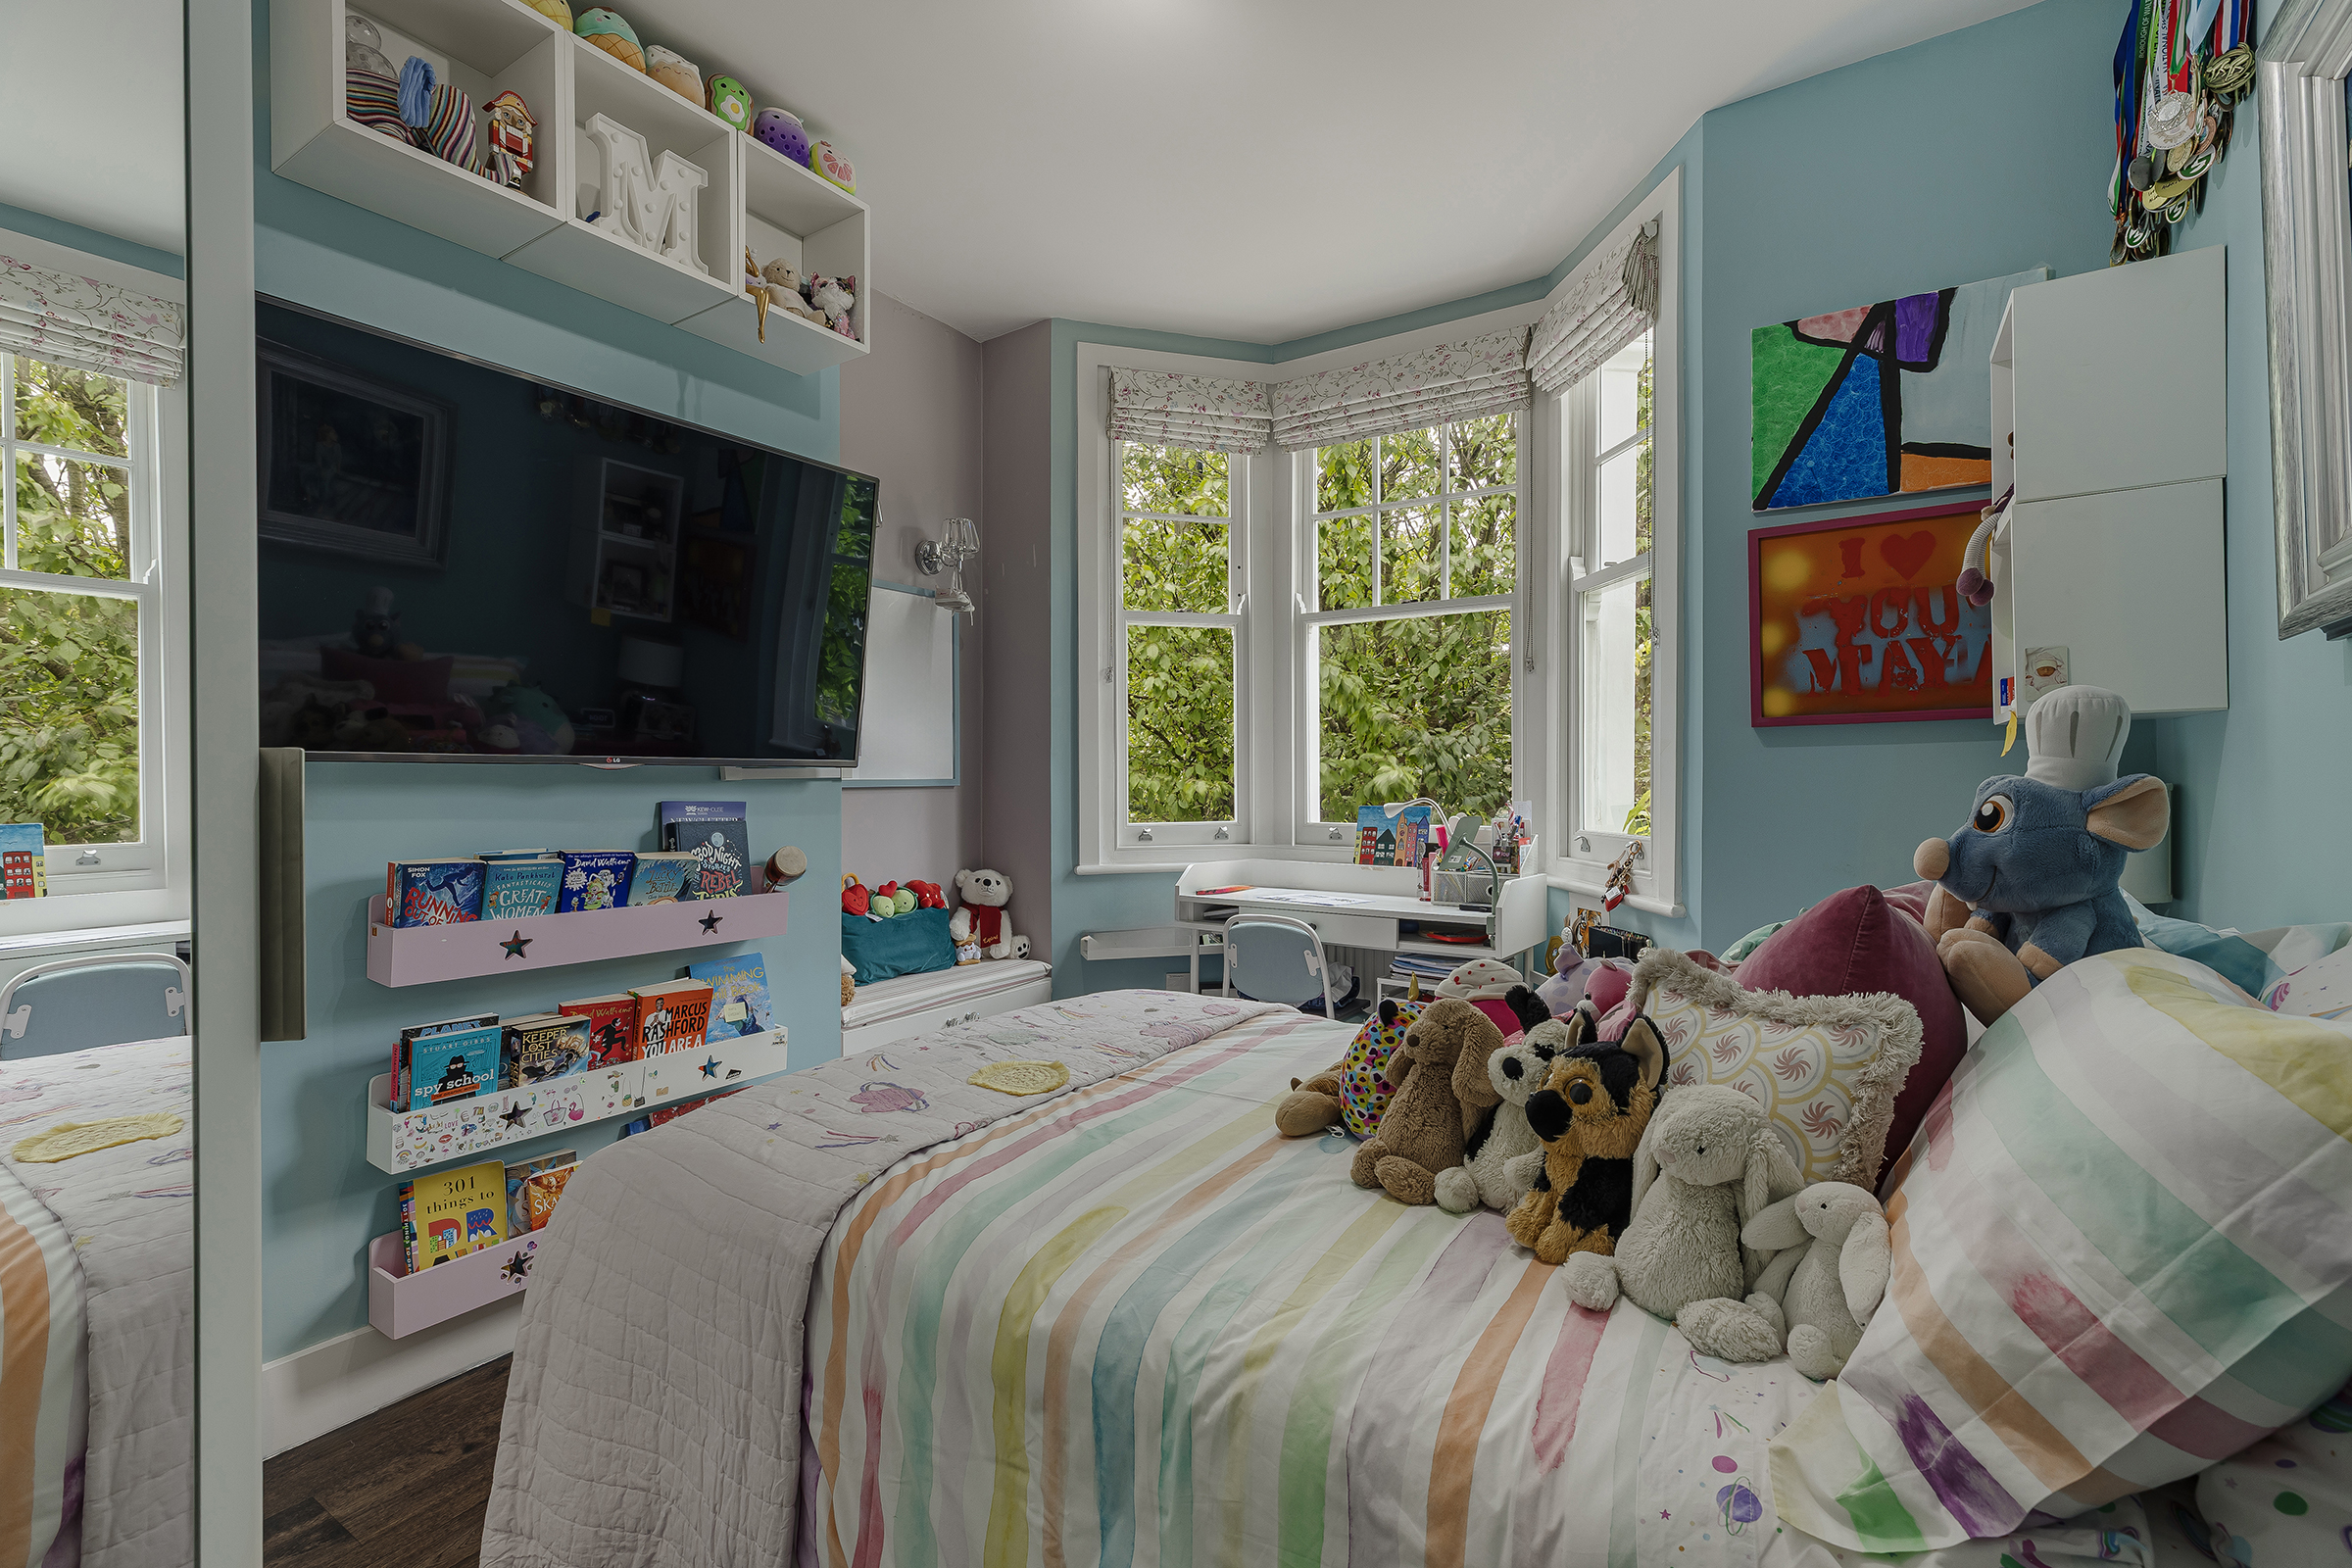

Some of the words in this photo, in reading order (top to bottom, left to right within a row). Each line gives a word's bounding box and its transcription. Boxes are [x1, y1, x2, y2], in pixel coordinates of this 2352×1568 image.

[2141, 16, 2150, 25] OF
[2138, 25, 2148, 59] BOROUGH
[1838, 537, 1866, 579] I
[1801, 583, 1959, 647] YOU
[568, 858, 596, 869] David
[597, 857, 631, 867] Walliams
[710, 846, 743, 870] NIGHT
[516, 871, 556, 880] Pankhurst
[646, 868, 682, 883] LUCKY
[701, 869, 741, 894] REBEL
[496, 880, 552, 891] FANTASTICALLY
[646, 882, 679, 895] BOTTLE
[499, 888, 547, 906] GREAT
[405, 906, 429, 922] OUT
[698, 966, 764, 988] WIMMING
[730, 981, 762, 998] Book
[595, 1006, 633, 1018] Walliams
[664, 1001, 708, 1021] MARCUS
[419, 1020, 482, 1037] PLANET
[522, 1029, 567, 1044] KEEPER
[642, 1015, 705, 1044] RASHFORD
[422, 1043, 459, 1054] STUART
[463, 1037, 491, 1047] GIBBS
[522, 1041, 554, 1054] LOST
[642, 1040, 667, 1059] YOU
[668, 1036, 692, 1054] ARE
[693, 1034, 703, 1048] A
[521, 1049, 559, 1063] CITIES
[415, 1082, 443, 1098] spy
[446, 1068, 495, 1090] school
[444, 1119, 459, 1129] LOVE
[443, 1176, 475, 1196] 301
[426, 1195, 474, 1214] things
[480, 1191, 494, 1200] to
[534, 1195, 561, 1215] SKA
